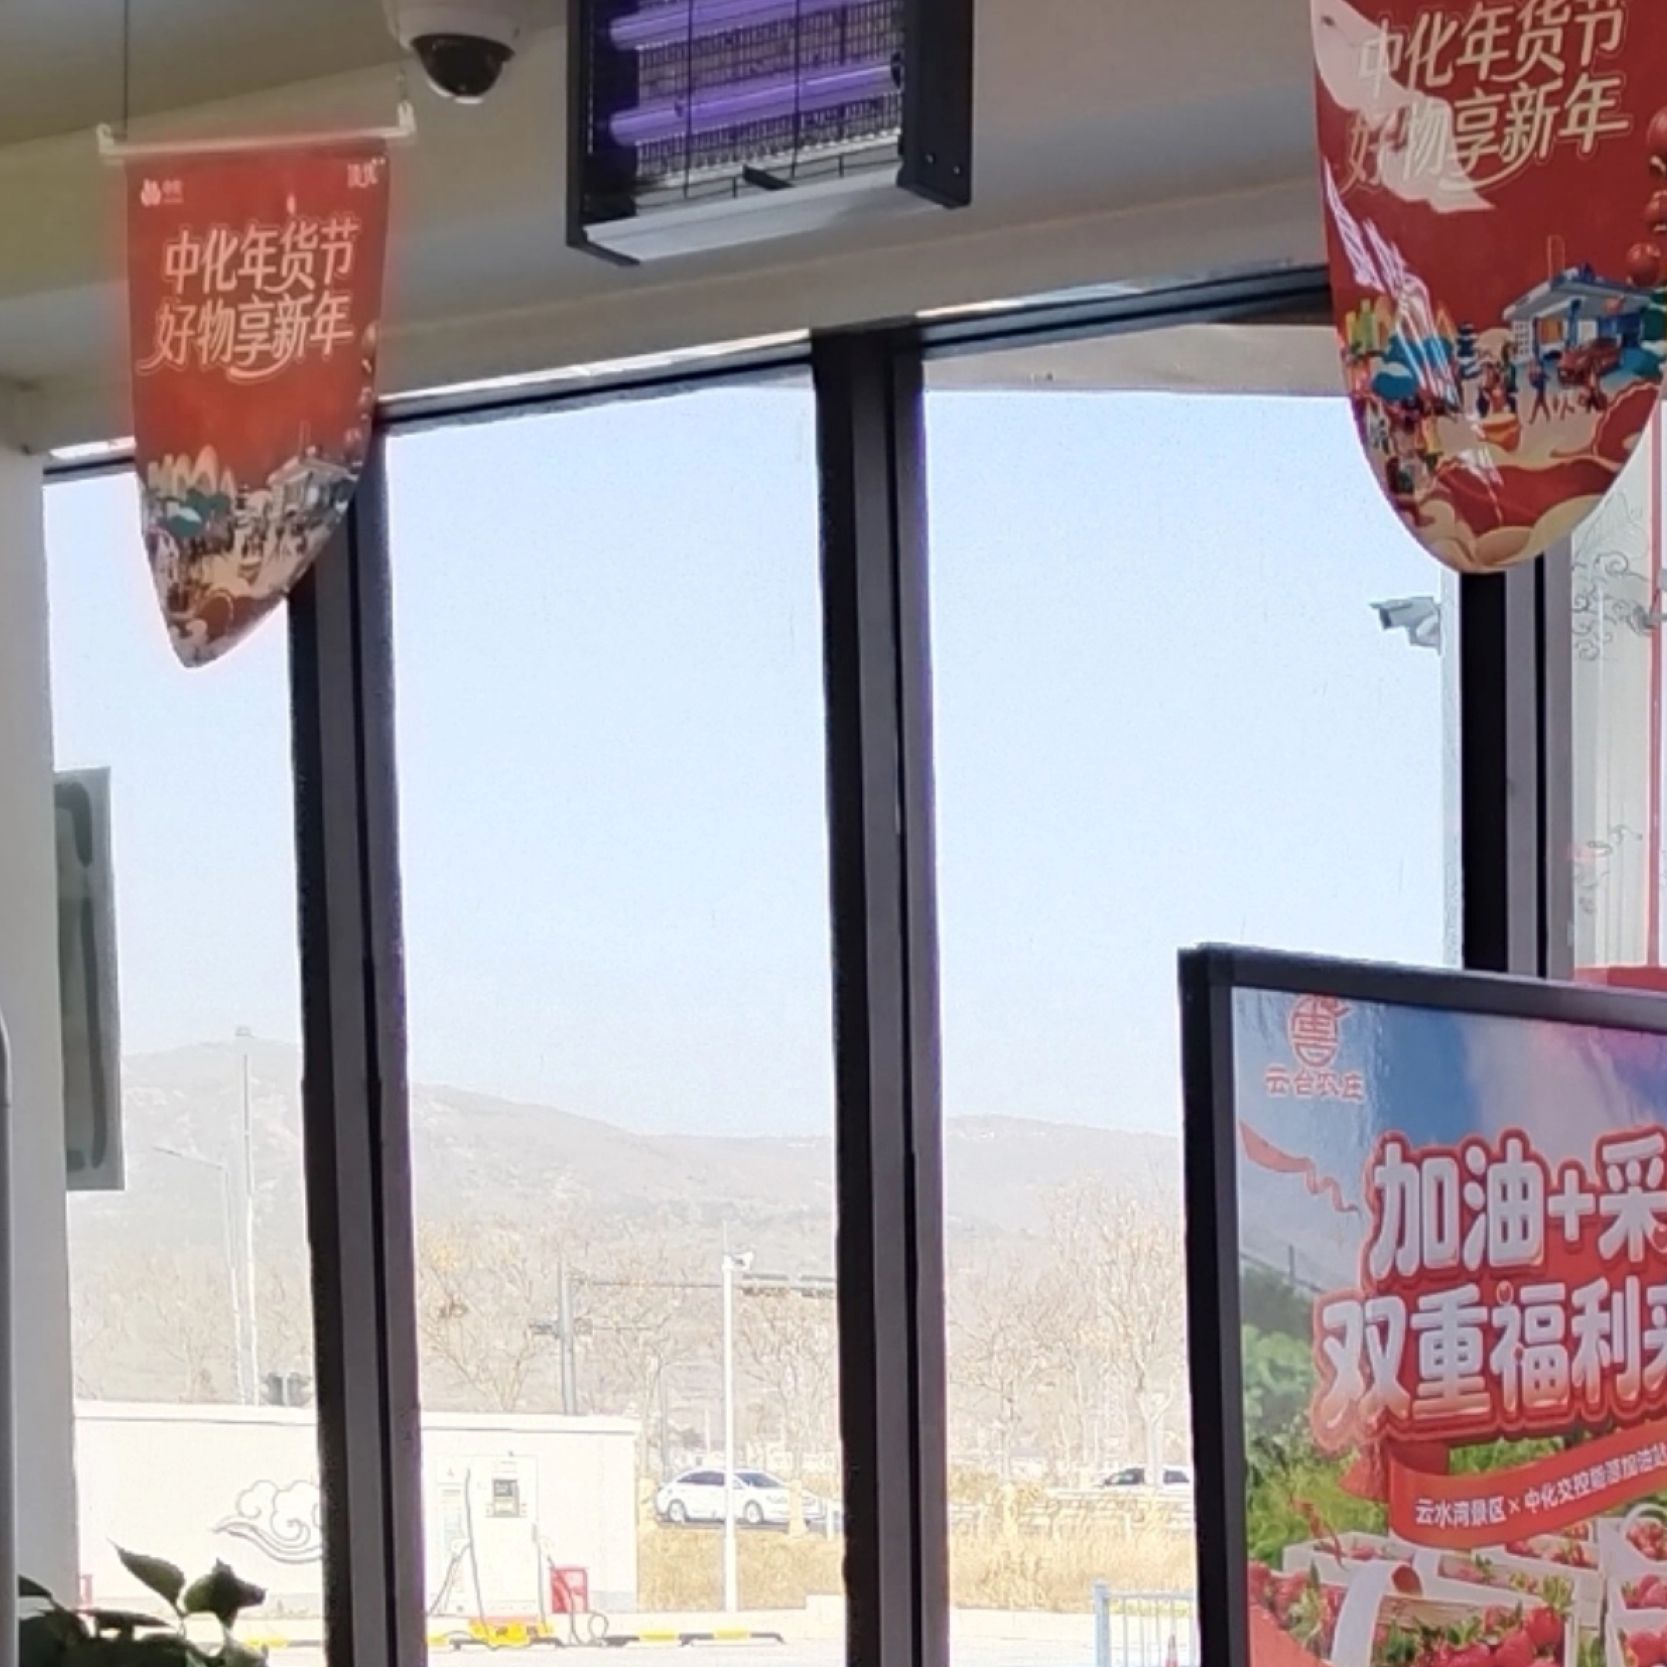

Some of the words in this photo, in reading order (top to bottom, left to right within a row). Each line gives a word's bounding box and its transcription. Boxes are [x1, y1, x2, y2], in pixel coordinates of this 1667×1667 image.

[1361, 0, 1623, 97] 中化年货节
[1340, 73, 1629, 194] 好物享新年
[165, 216, 360, 294] 中化年货节
[138, 291, 354, 378] 好物享新年
[1265, 1066, 1364, 1100] 云台农庄
[1414, 1496, 1506, 1529] 云水湾景区
